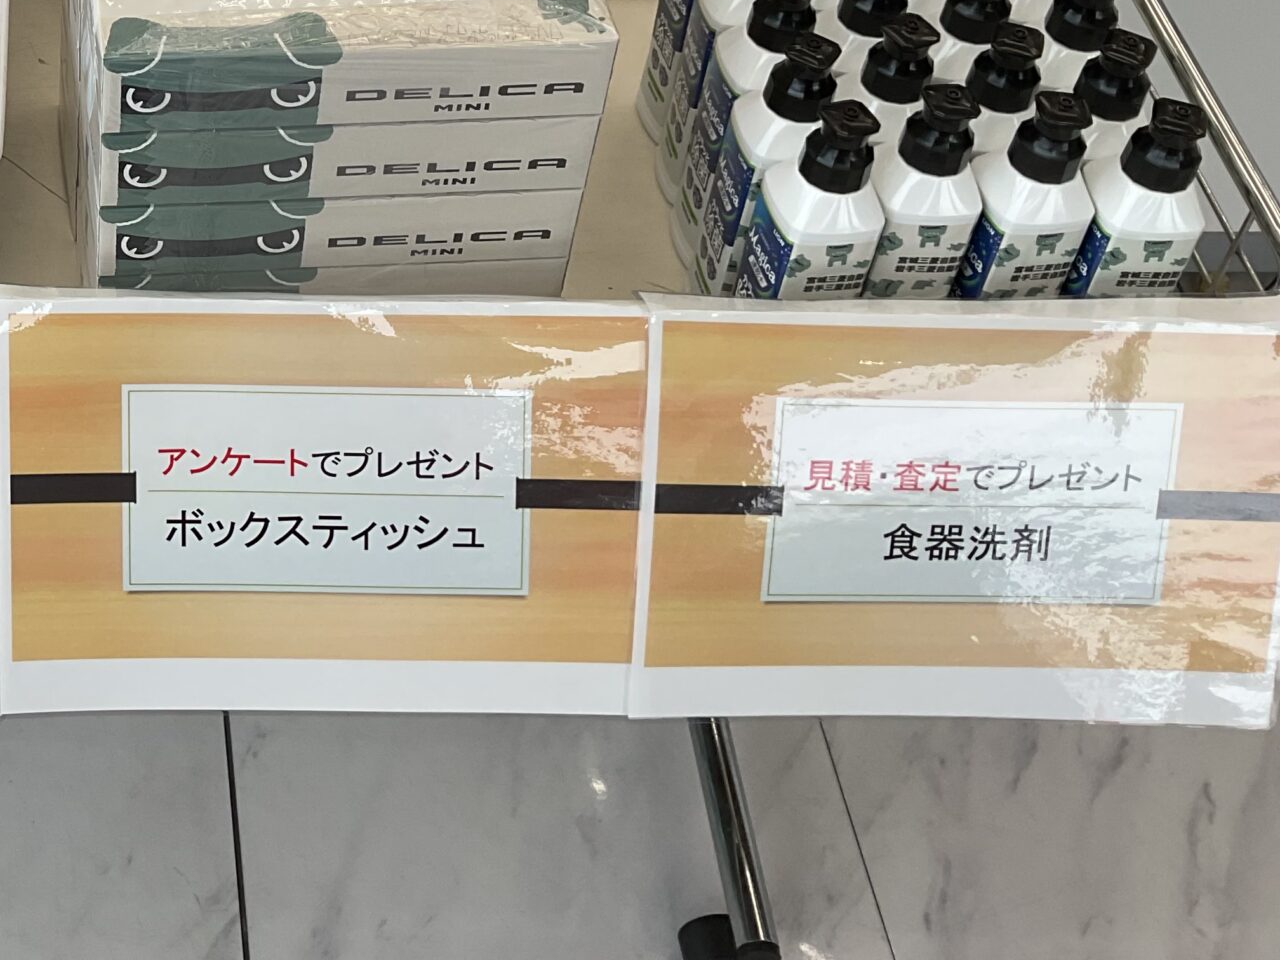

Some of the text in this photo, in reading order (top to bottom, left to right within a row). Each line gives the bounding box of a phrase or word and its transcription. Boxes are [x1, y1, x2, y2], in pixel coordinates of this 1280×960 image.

[345, 82, 585, 102] DELICA
[433, 102, 491, 113] MINI
[336, 157, 568, 177] DELICA
[421, 177, 477, 187] MINI
[327, 228, 553, 249] DELICA
[410, 247, 464, 257] MINI
[748, 226, 776, 285] Magica
[157, 446, 495, 481] アンケートでプレゼント
[803, 459, 1144, 494] 見積・査定でプレゼント
[165, 507, 486, 552] ボックスティッシュ
[882, 522, 1053, 563] 食器洗剤
